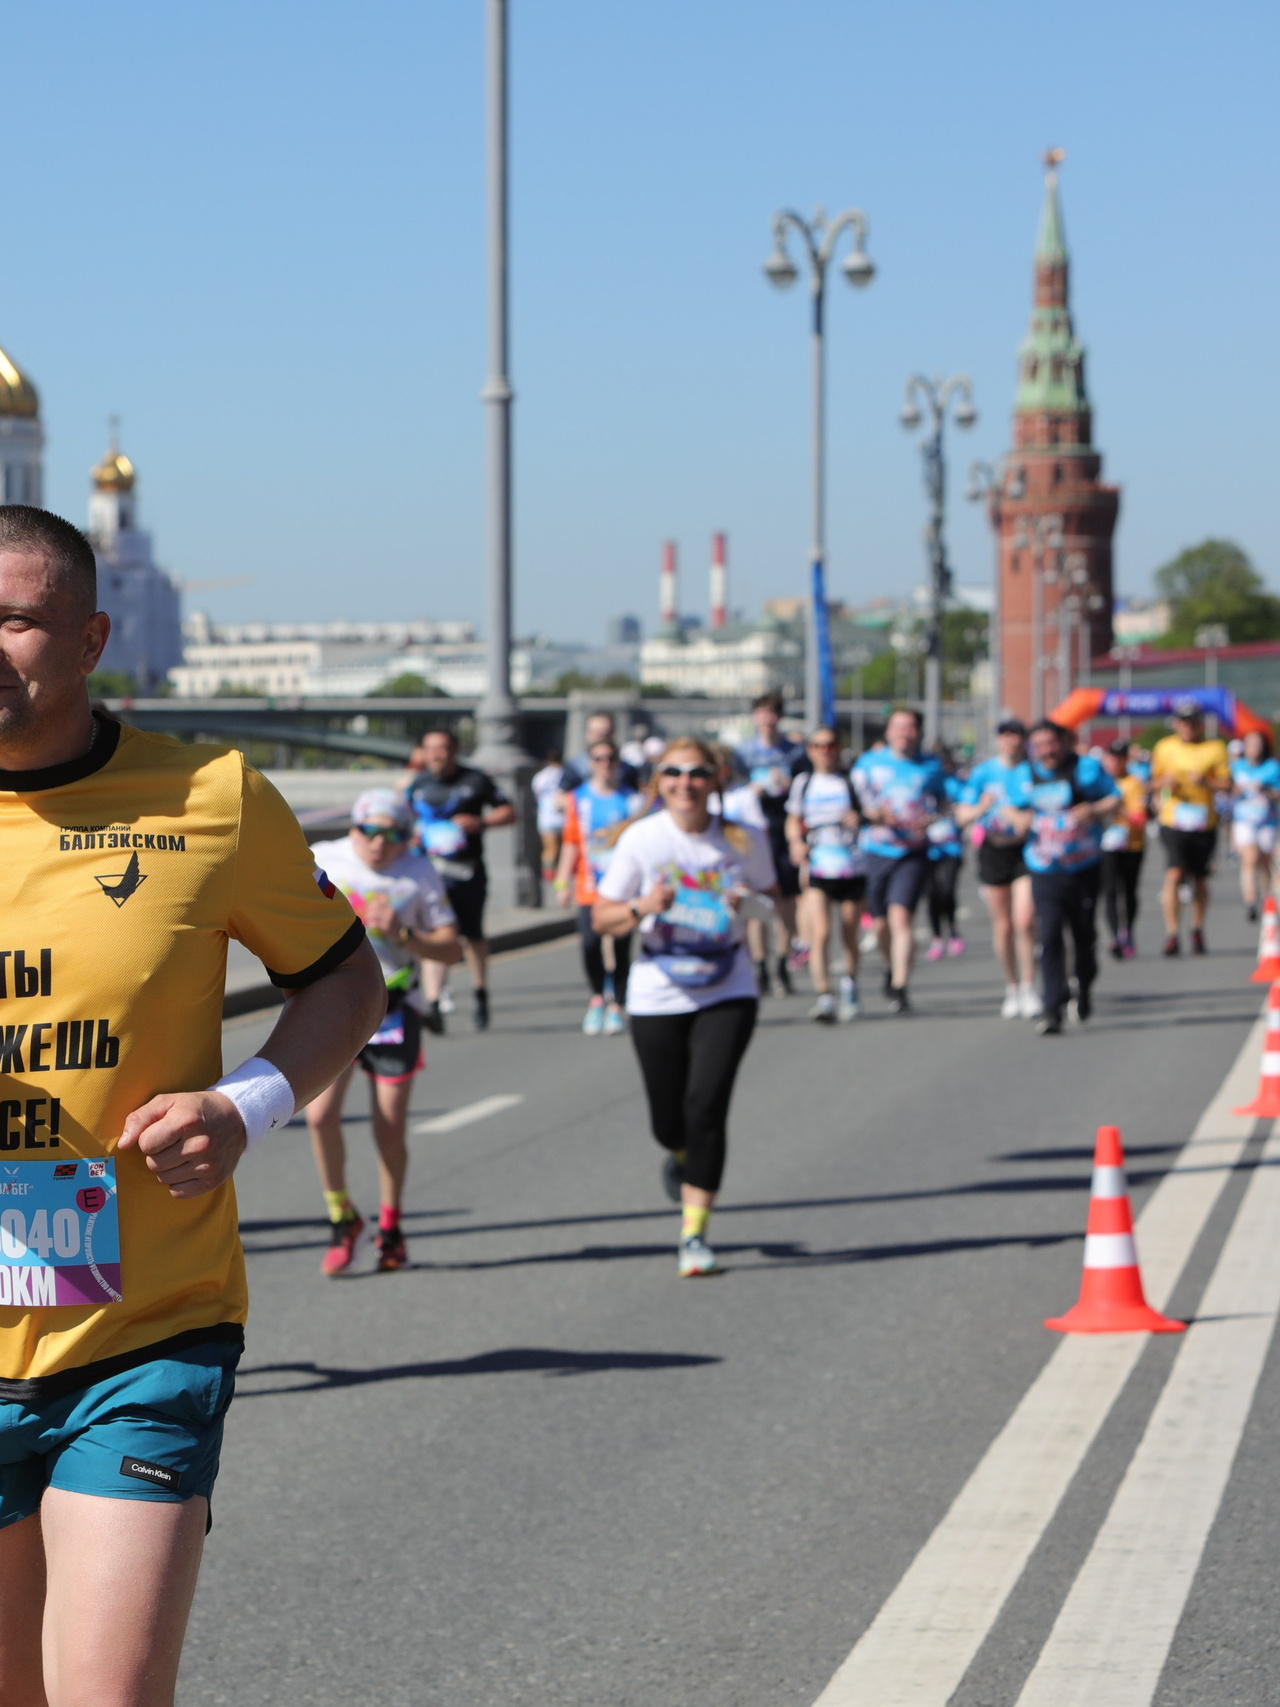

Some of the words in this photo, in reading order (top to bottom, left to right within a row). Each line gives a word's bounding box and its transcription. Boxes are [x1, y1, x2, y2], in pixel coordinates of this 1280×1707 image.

[90, 824, 131, 832] КОМПАНИЙ
[60, 833, 186, 851] БАЛТЭКСКОМ
[131, 1463, 155, 1476] Calvin
[154, 1469, 172, 1481] Klein
